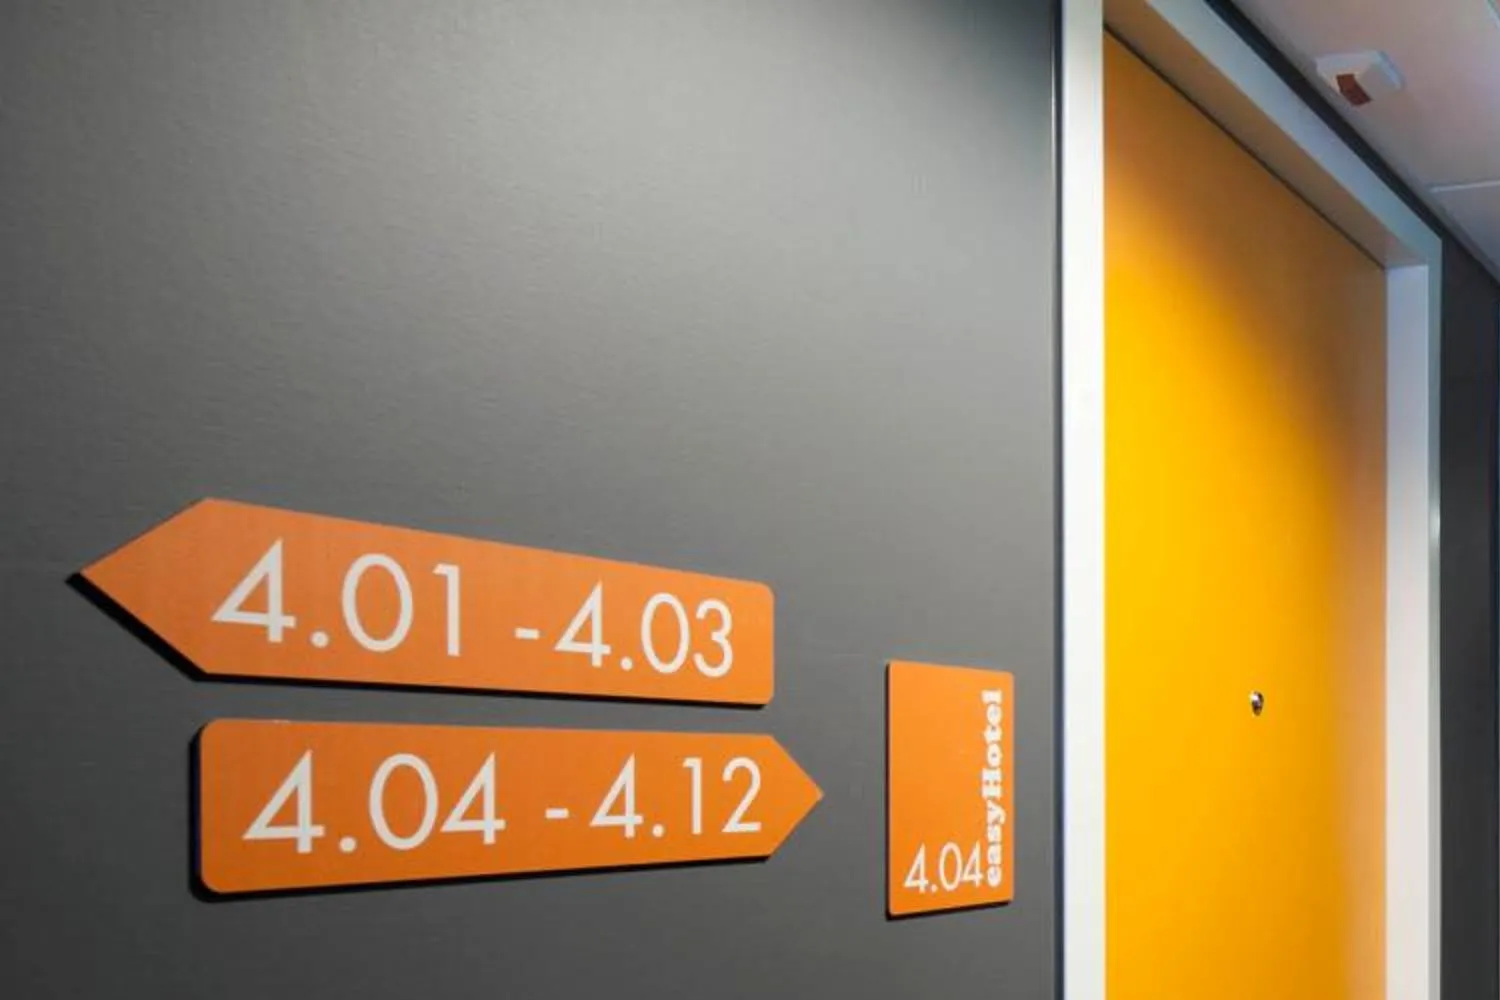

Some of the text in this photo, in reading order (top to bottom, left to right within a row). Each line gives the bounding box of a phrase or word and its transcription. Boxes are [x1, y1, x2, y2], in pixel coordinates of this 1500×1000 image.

[211, 539, 461, 657] 4.01
[243, 751, 506, 853] 4.04
[980, 689, 1006, 888] easyHotel
[904, 841, 984, 893] 4.04
